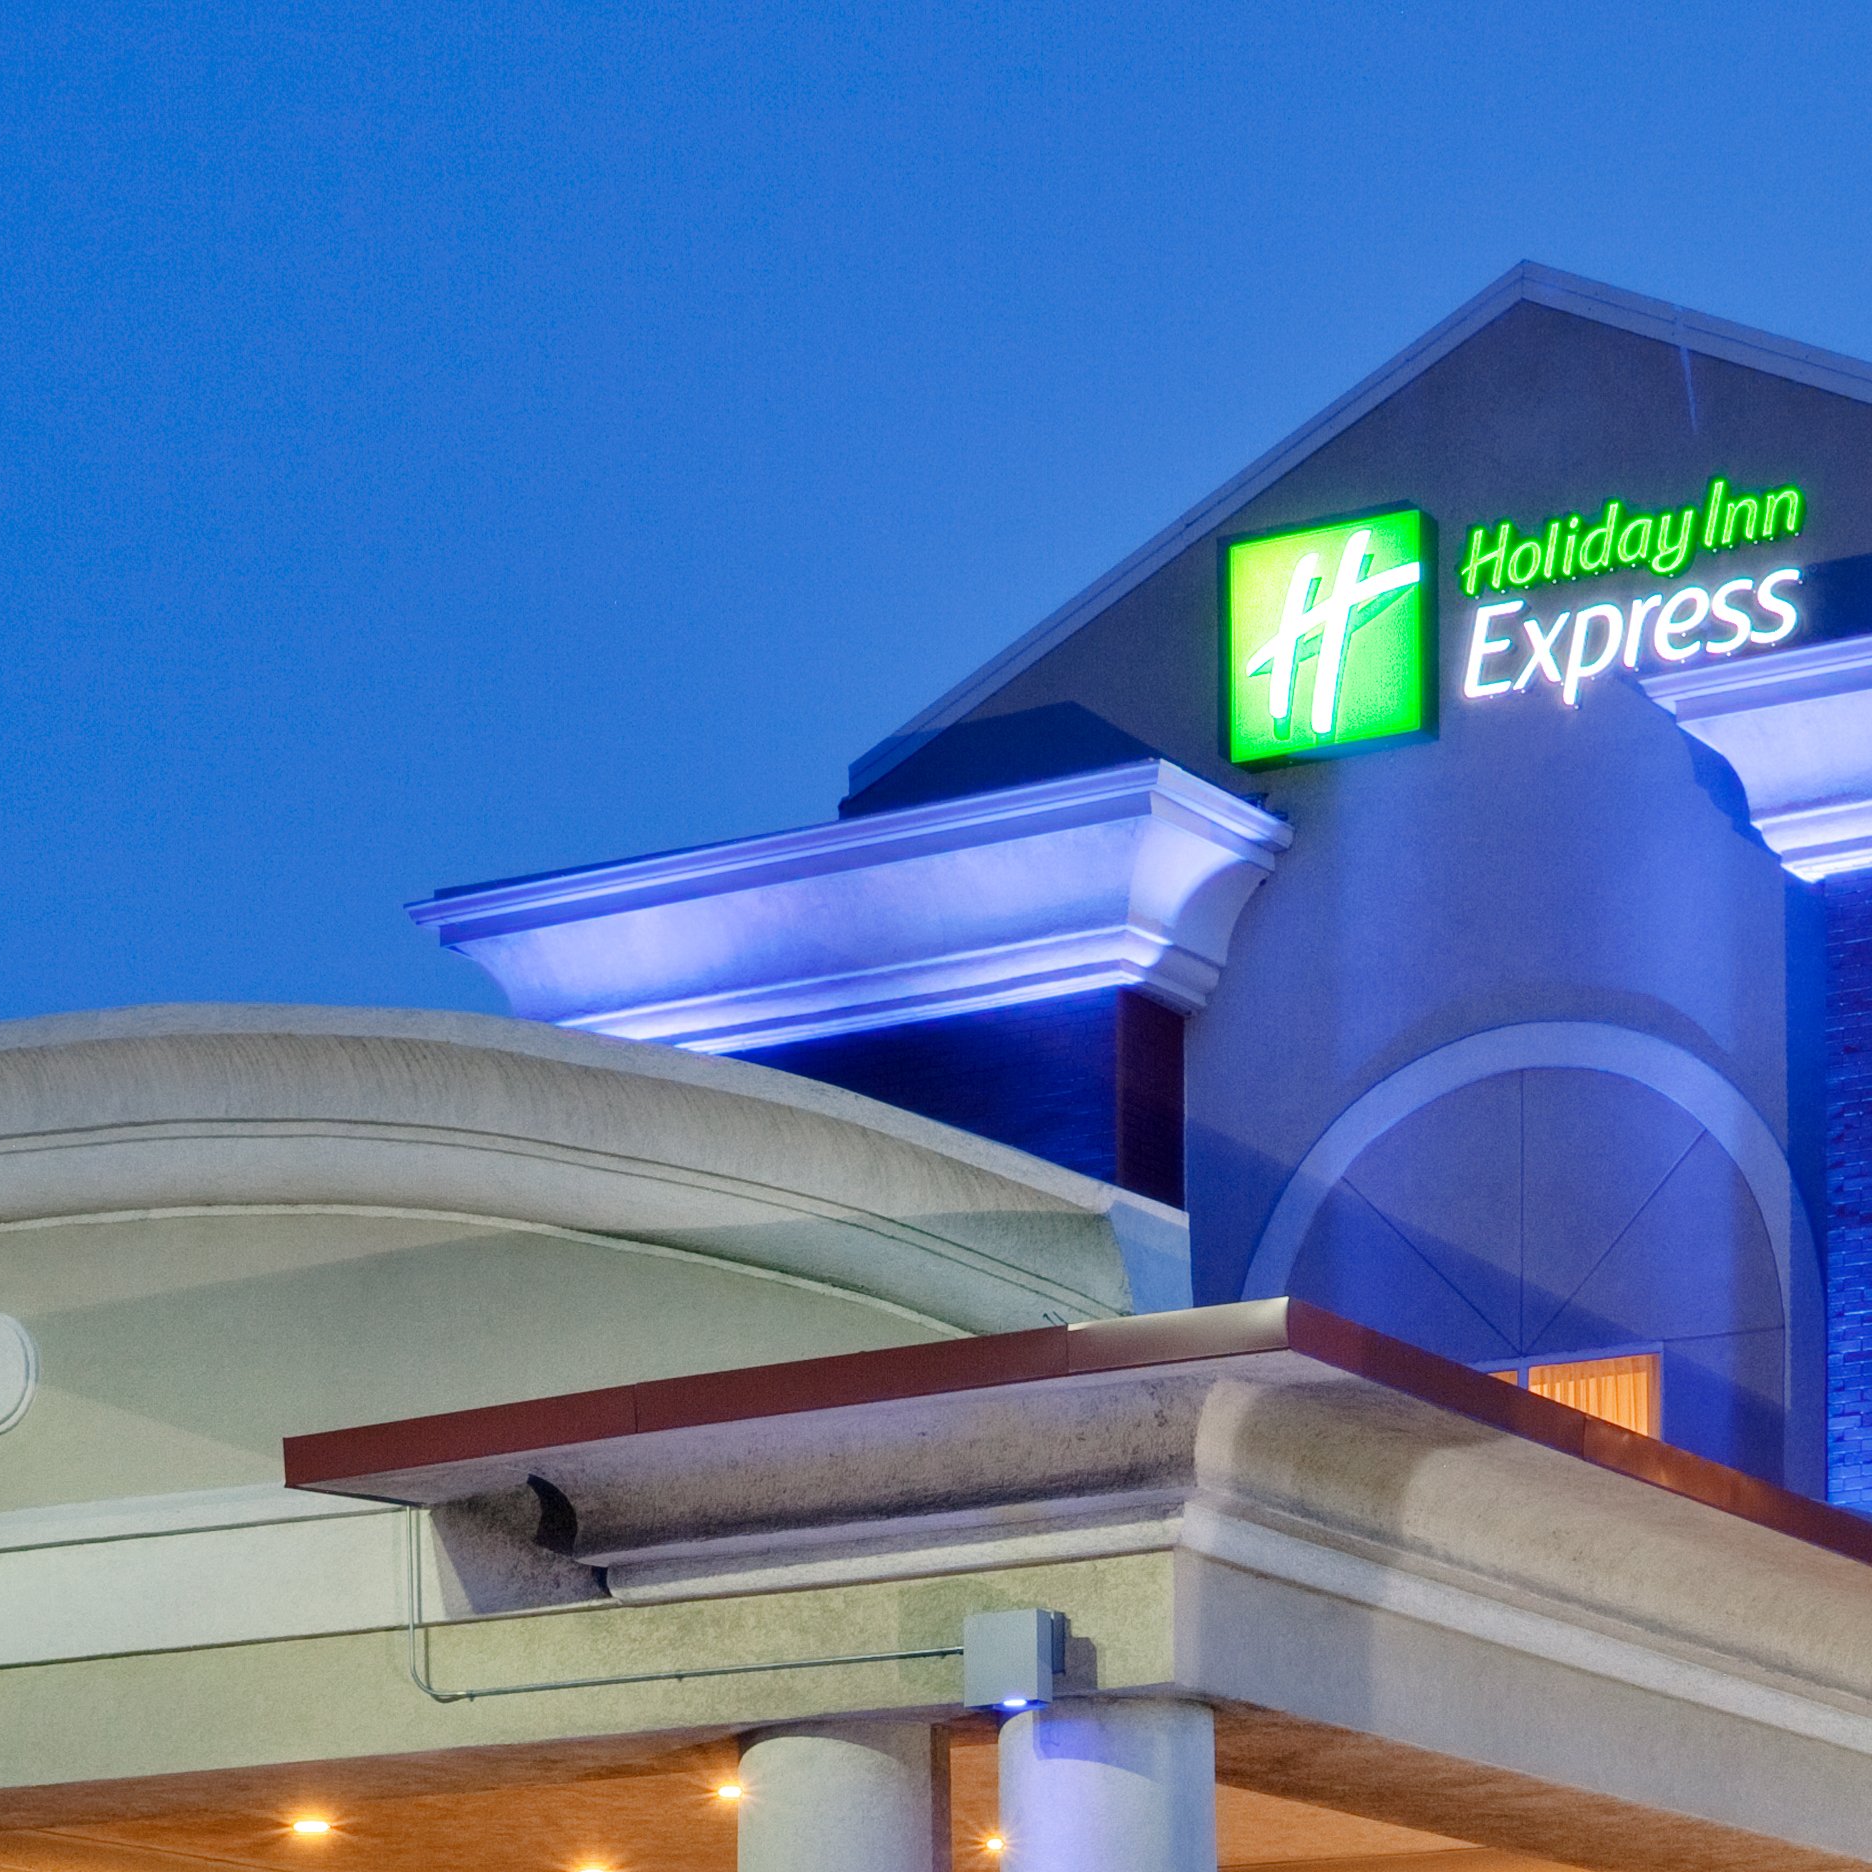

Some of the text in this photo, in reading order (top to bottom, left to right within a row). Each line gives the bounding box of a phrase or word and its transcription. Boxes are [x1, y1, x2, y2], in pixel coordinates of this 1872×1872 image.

[1460, 479, 1802, 595] Holiday Inn
[1462, 568, 1802, 706] Express
